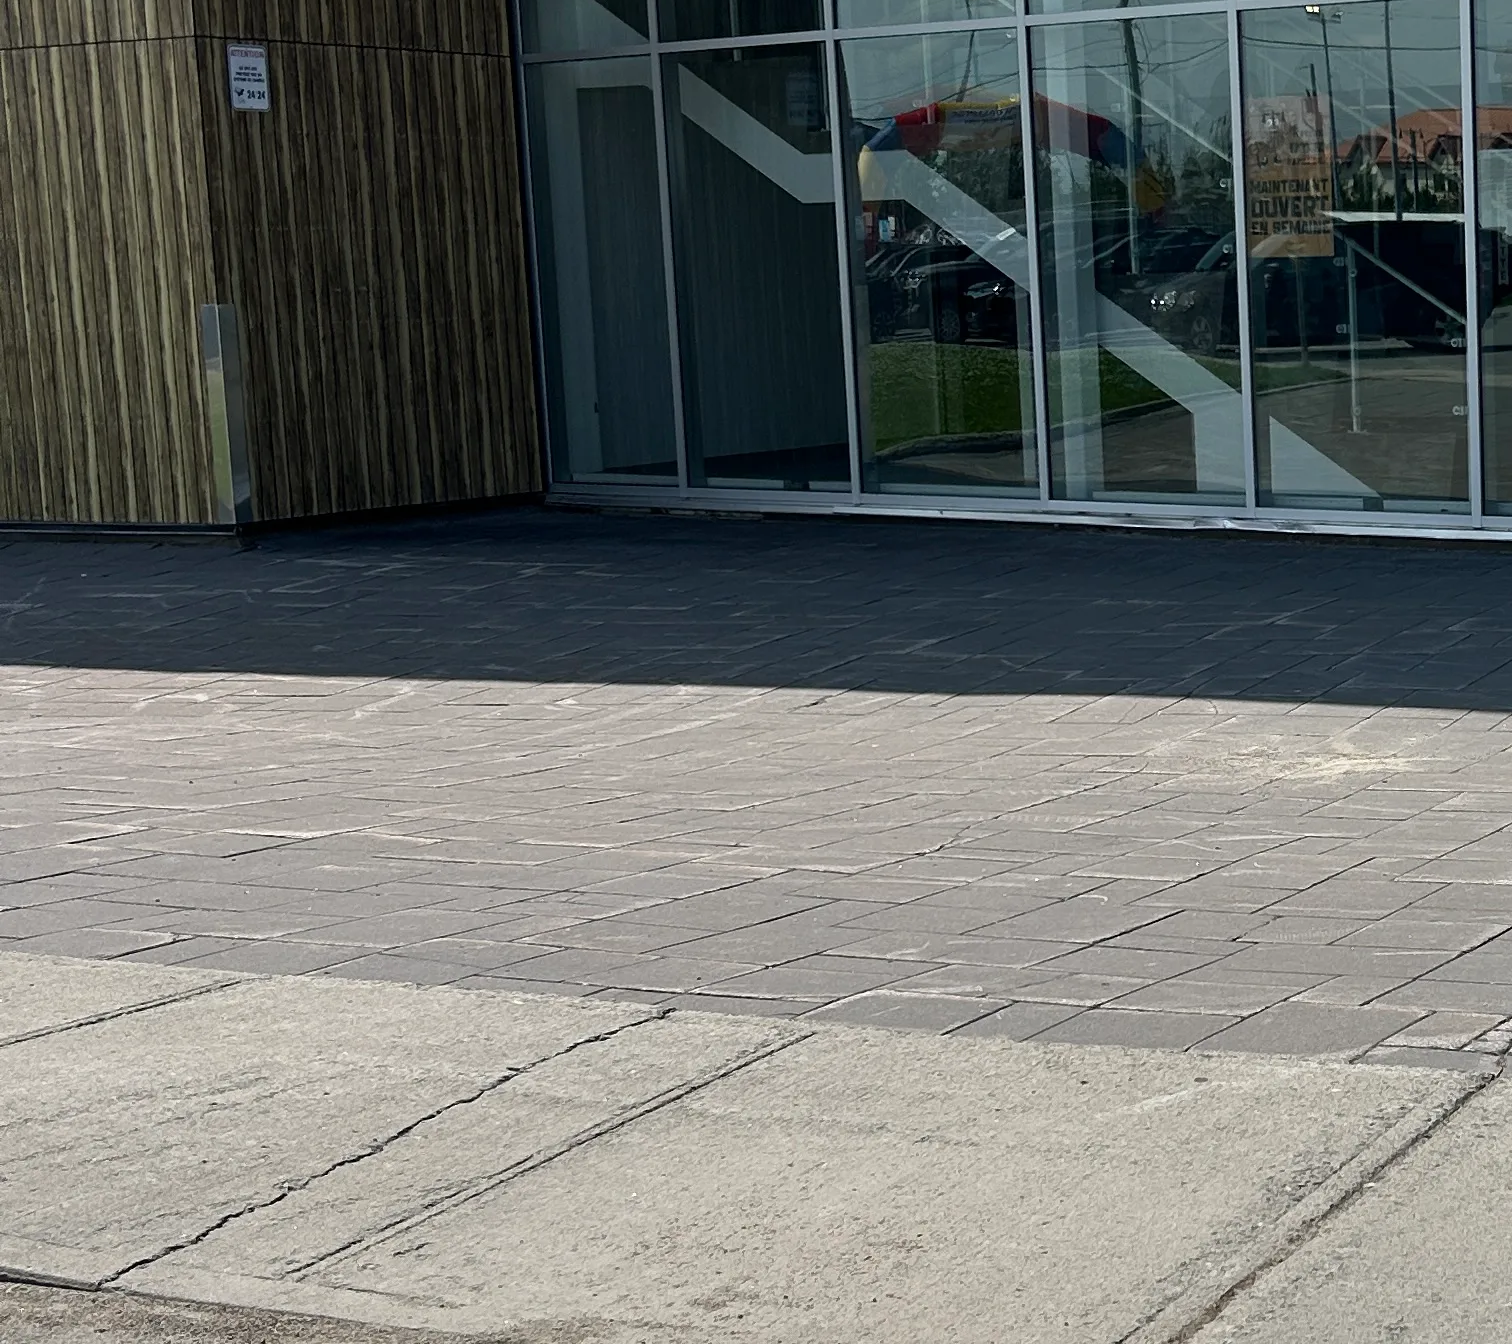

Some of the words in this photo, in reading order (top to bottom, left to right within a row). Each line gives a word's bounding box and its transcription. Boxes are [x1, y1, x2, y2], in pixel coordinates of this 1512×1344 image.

[1249, 179, 1329, 194] MAINTENANT
[1251, 196, 1330, 218] OUVERT
[1251, 221, 1268, 235] EN
[1273, 220, 1331, 235] SEMAINE
